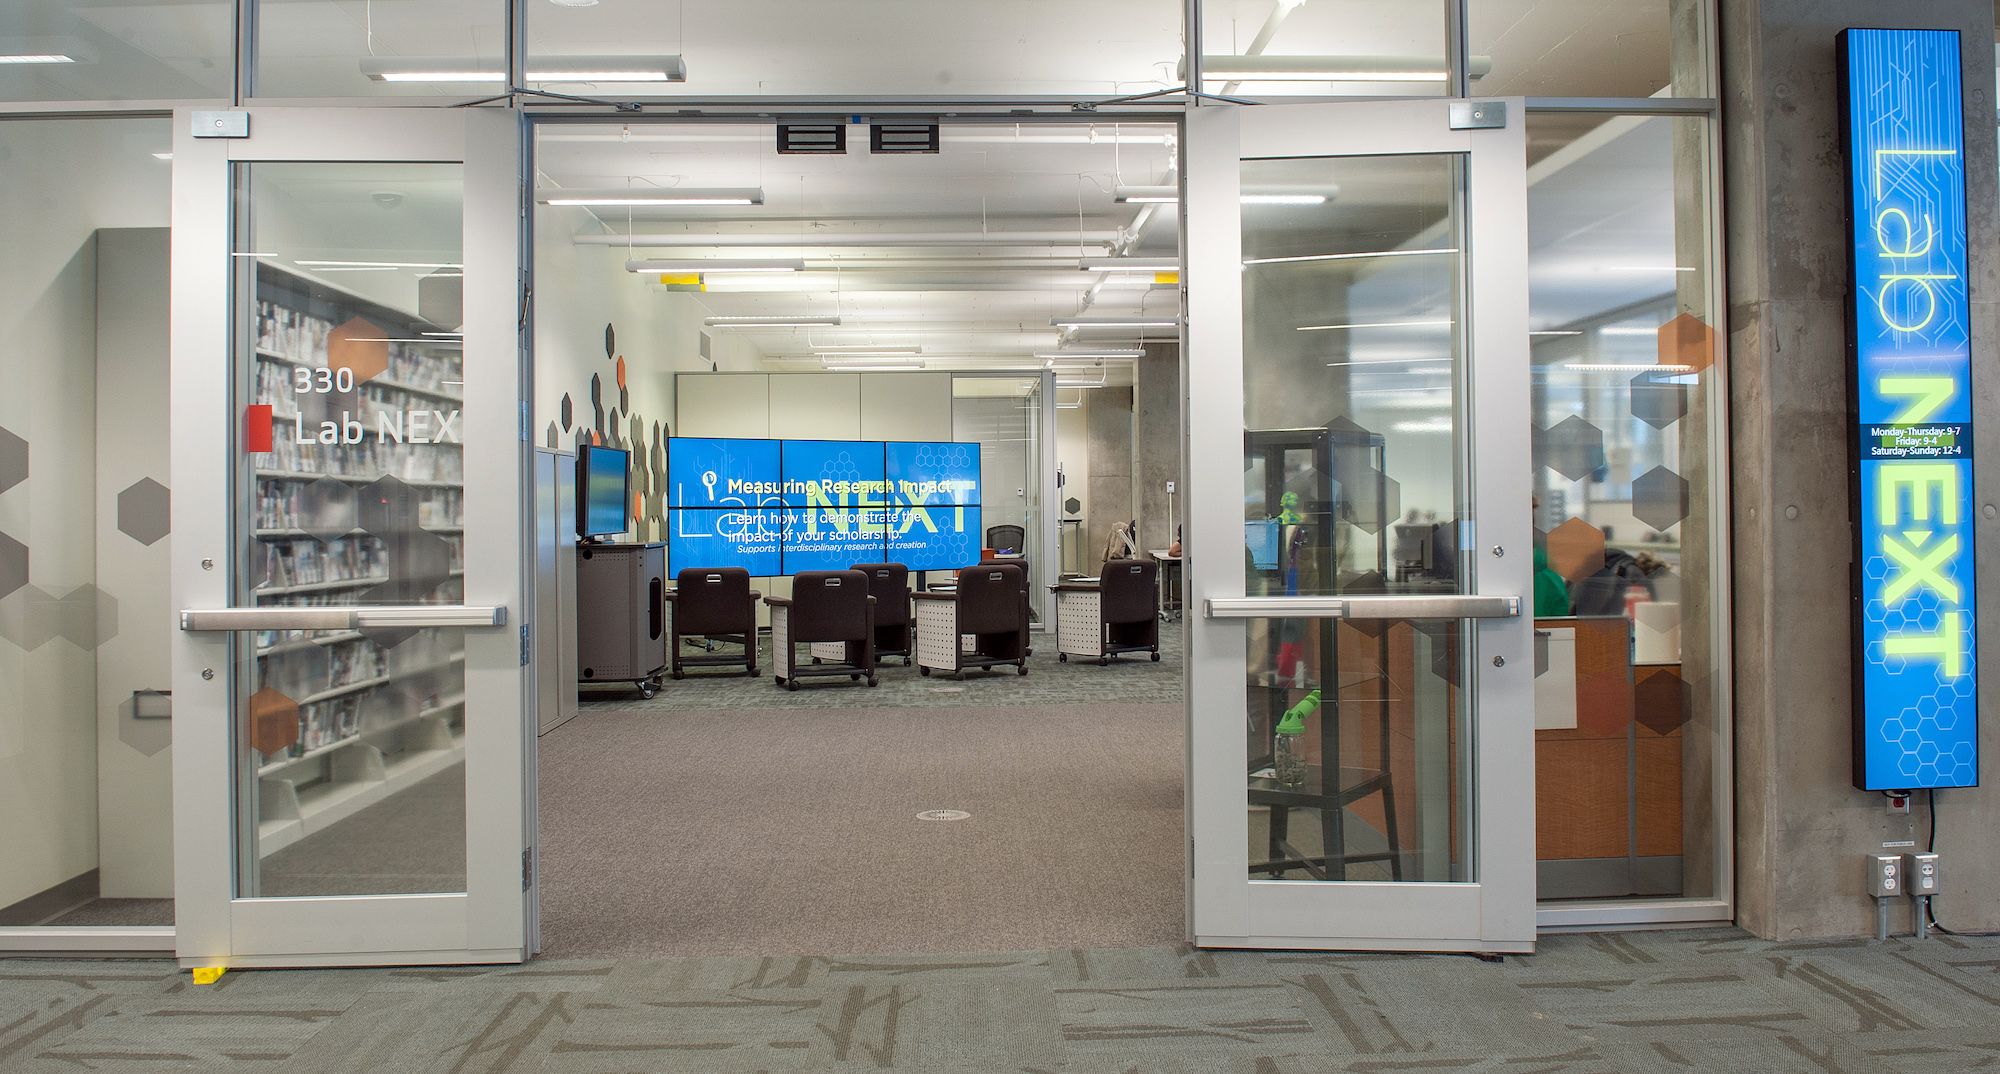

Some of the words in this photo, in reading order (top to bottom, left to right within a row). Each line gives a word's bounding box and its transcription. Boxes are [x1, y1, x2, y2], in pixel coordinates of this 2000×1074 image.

[1875, 149, 1957, 333] Lab
[294, 367, 354, 393] 330
[295, 411, 364, 445] Lab
[378, 410, 460, 444] NEX
[1871, 427, 1946, 438] Monday-Thursday:
[1947, 427, 1961, 436] 9-7
[1895, 437, 1922, 447] Friday:
[1923, 437, 1937, 445] 9-4
[1871, 446, 1942, 457] Saturday-Sunday:
[1943, 446, 1962, 455] 12-4
[728, 478, 817, 497] Measuring
[822, 478, 895, 495] Research
[899, 479, 952, 496] Impact
[679, 481, 792, 539] Lab
[806, 480, 976, 536] NEXT
[728, 512, 766, 525] Learn
[770, 511, 799, 524] how
[802, 512, 817, 524] to
[820, 510, 898, 524] demonstrate
[902, 510, 922, 522] the
[728, 530, 776, 545] impact
[779, 529, 793, 542] of
[796, 531, 826, 543] your
[829, 528, 902, 542] scholarship.
[1879, 378, 1959, 677] NEXT
[737, 544, 776, 555] Supports
[777, 543, 842, 553] interdisciplinary
[843, 542, 878, 551] research
[879, 541, 894, 550] and
[895, 541, 927, 550] creation
